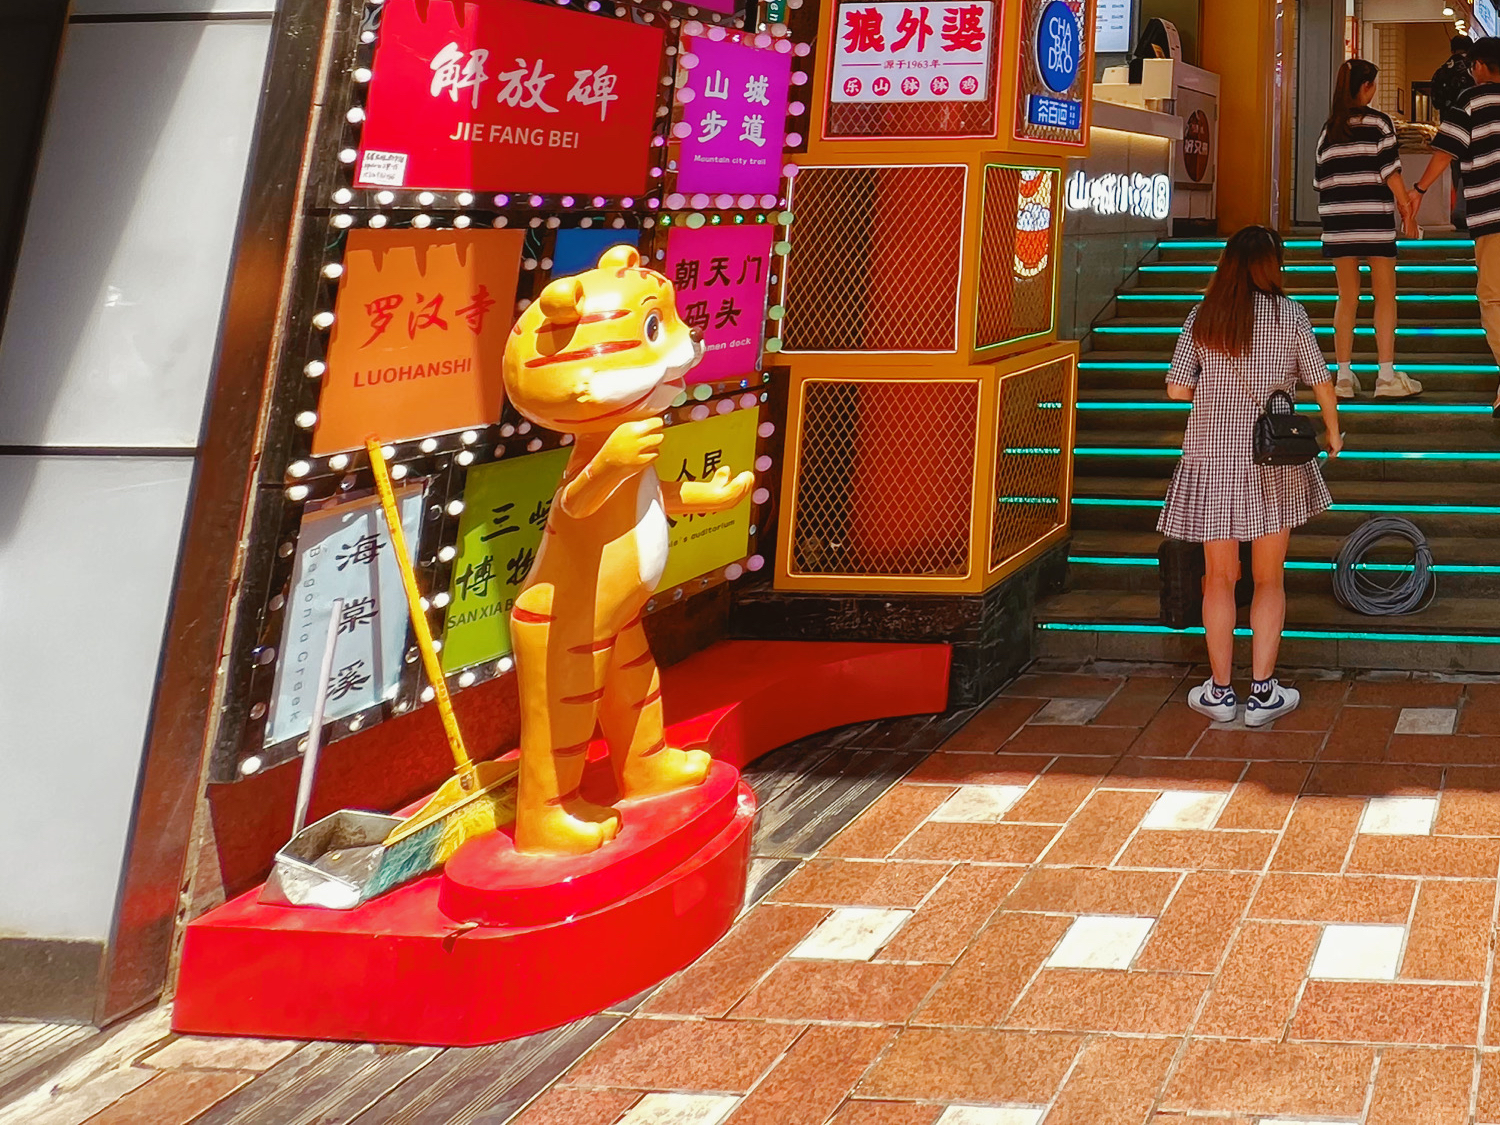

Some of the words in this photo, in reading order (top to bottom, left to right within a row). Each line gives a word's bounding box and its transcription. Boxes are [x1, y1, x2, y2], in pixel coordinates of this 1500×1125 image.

[841, 4, 986, 54] 狼外婆
[1049, 16, 1072, 42] CHA
[1048, 47, 1073, 74] DAO
[1055, 35, 1071, 56] BAI
[883, 59, 941, 70] 源于1963年
[429, 41, 619, 121] 解放碑
[704, 69, 770, 107] 山城
[844, 77, 977, 94] 乐山钵钵鸡
[449, 120, 483, 142] JIE
[489, 124, 544, 146] FANG
[548, 129, 579, 149] BEI
[697, 110, 767, 147] 步道
[694, 154, 730, 164] Mountain
[732, 157, 748, 166] city
[674, 255, 762, 291] 朝天门
[358, 284, 497, 350] 罗汉寺
[684, 297, 742, 331] 码头
[353, 357, 472, 389] LUOHANSHI
[325, 532, 387, 702] 海棠溪
[446, 608, 478, 630] SAN
[479, 602, 503, 620] XIA
